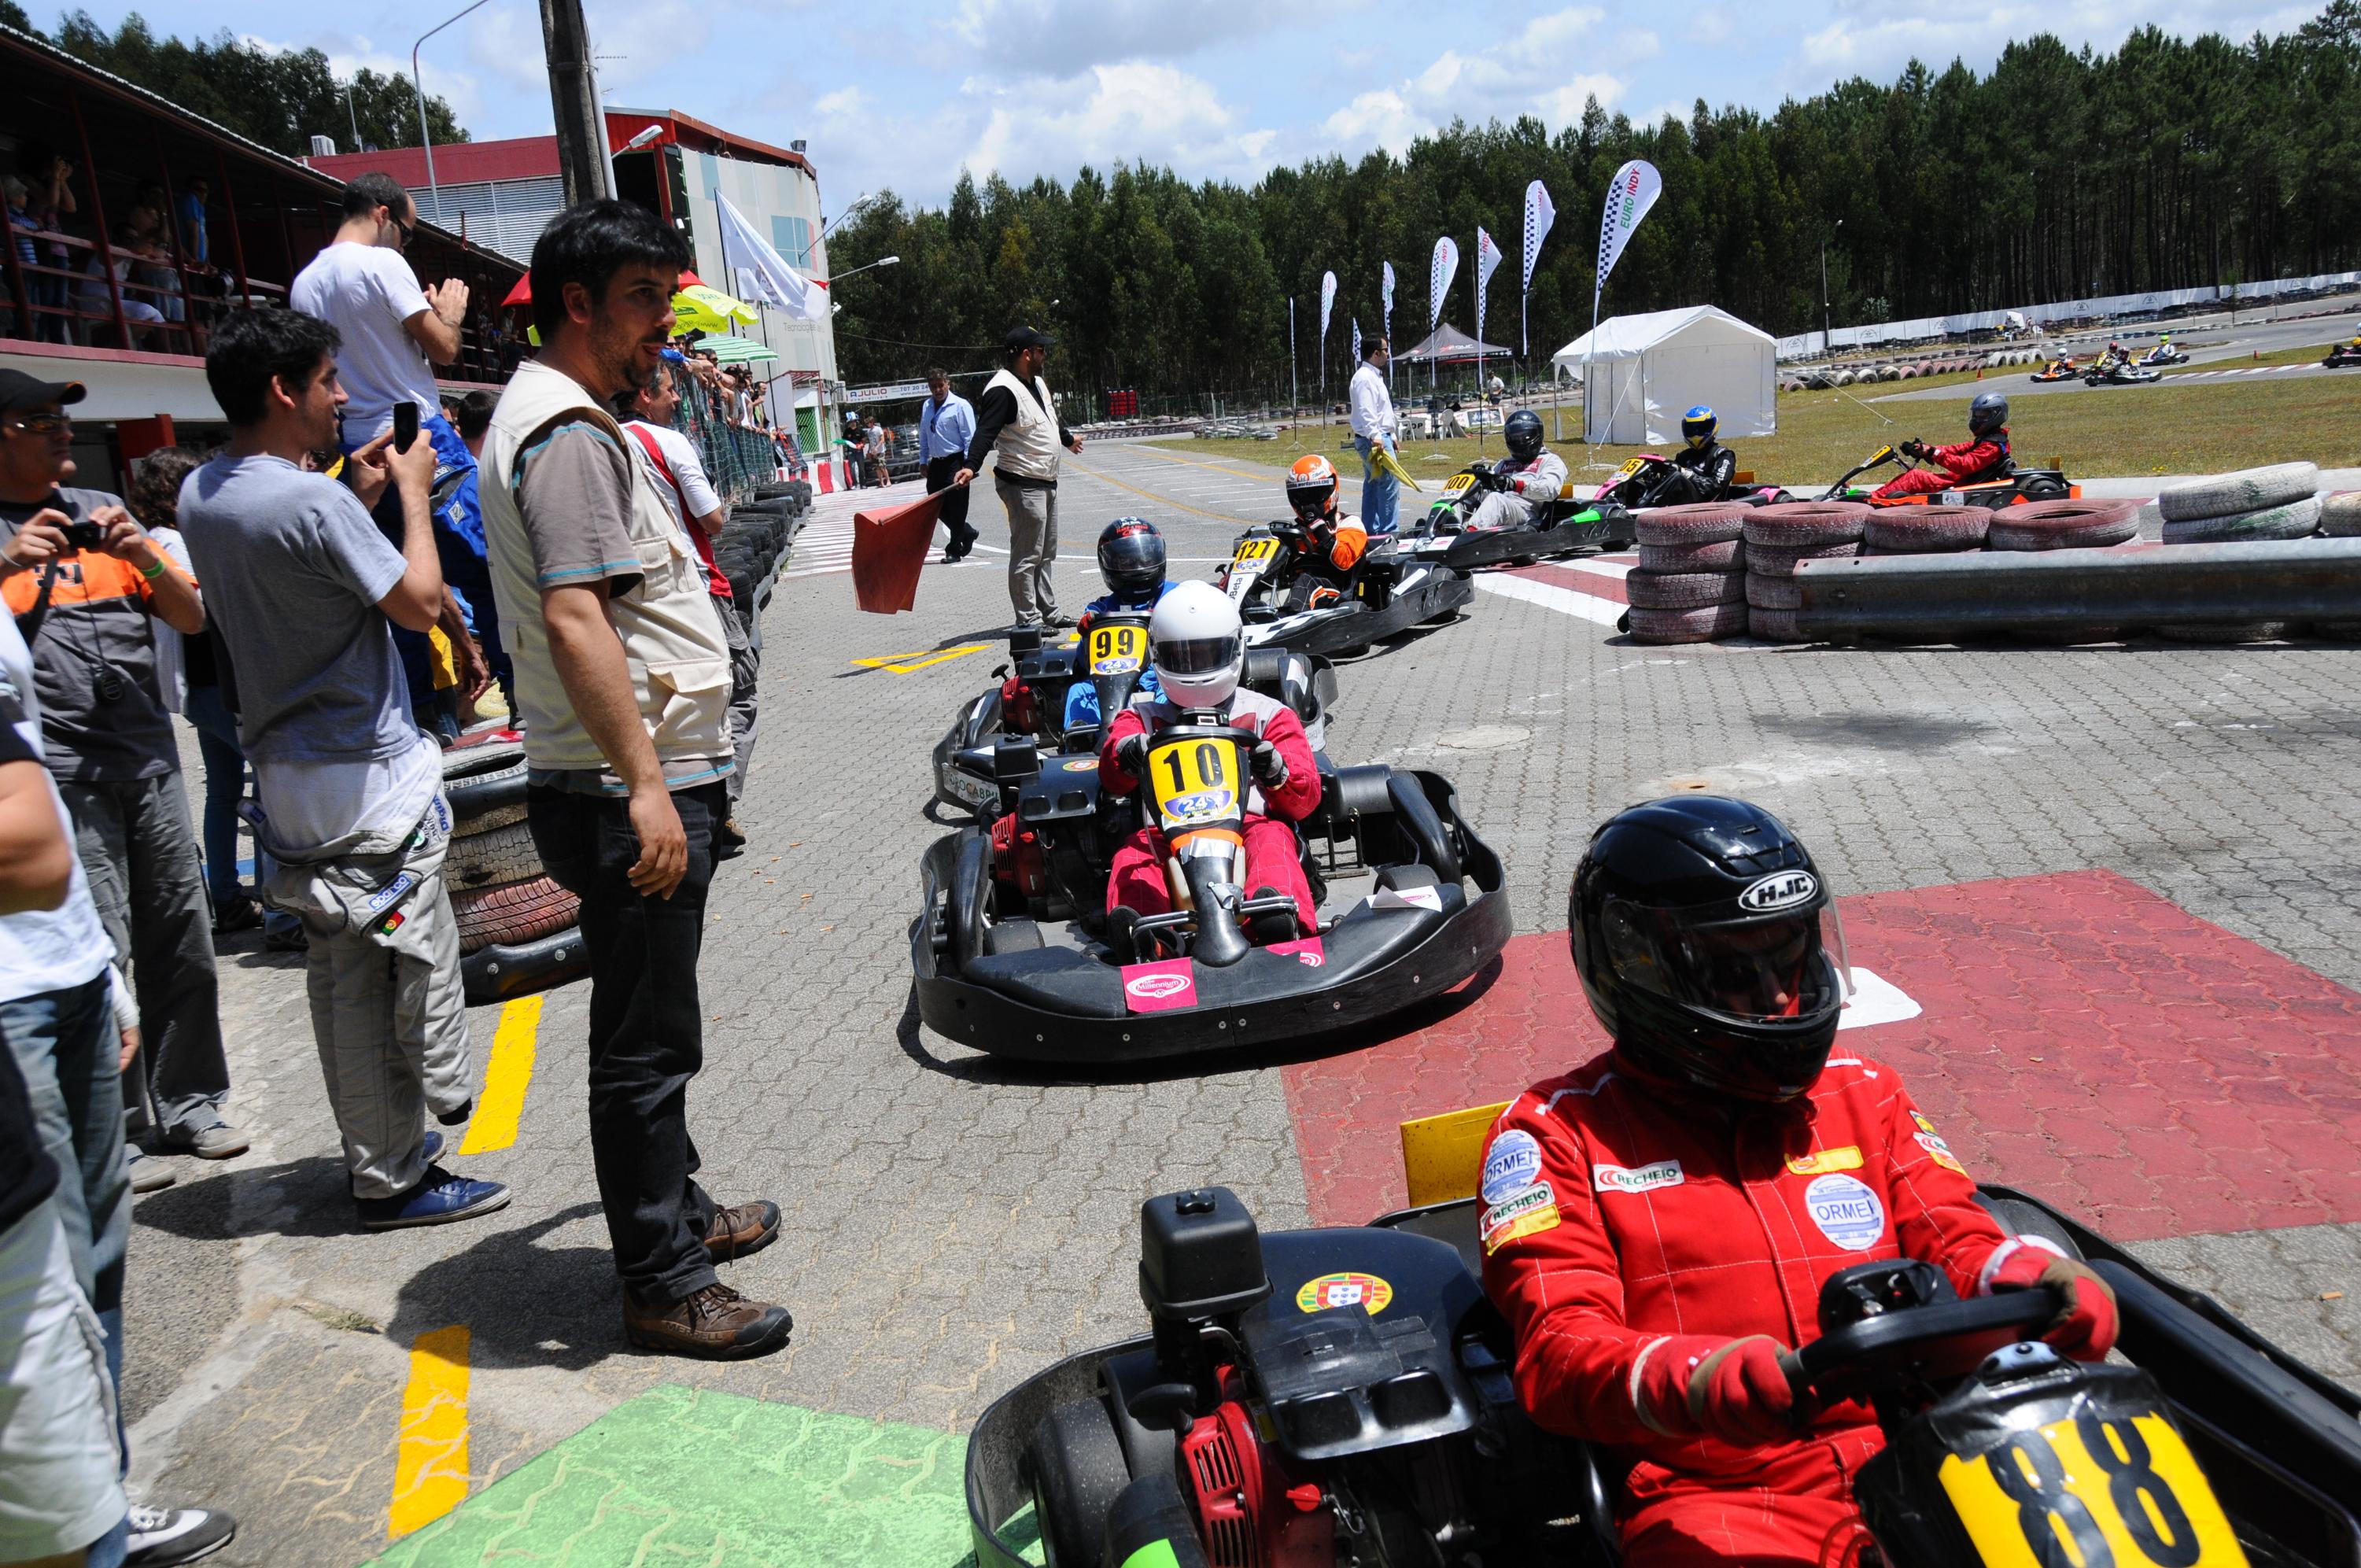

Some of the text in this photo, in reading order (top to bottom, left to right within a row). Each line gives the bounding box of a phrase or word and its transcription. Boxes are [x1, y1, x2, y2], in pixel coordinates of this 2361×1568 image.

[1621, 168, 1640, 229] EURO INDY
[1444, 476, 1470, 490] 100
[1238, 540, 1271, 561] 127
[1096, 629, 1134, 659] 99
[1163, 743, 1224, 793] 10
[1181, 796, 1208, 814] 24
[371, 876, 408, 906] sparco
[1758, 876, 1809, 906] HJC
[1136, 980, 1179, 991] Millennium
[1618, 1168, 1677, 1186] RECHEIO
[1493, 1190, 1548, 1221] RECHEIO
[1983, 1413, 2202, 1568] 88
